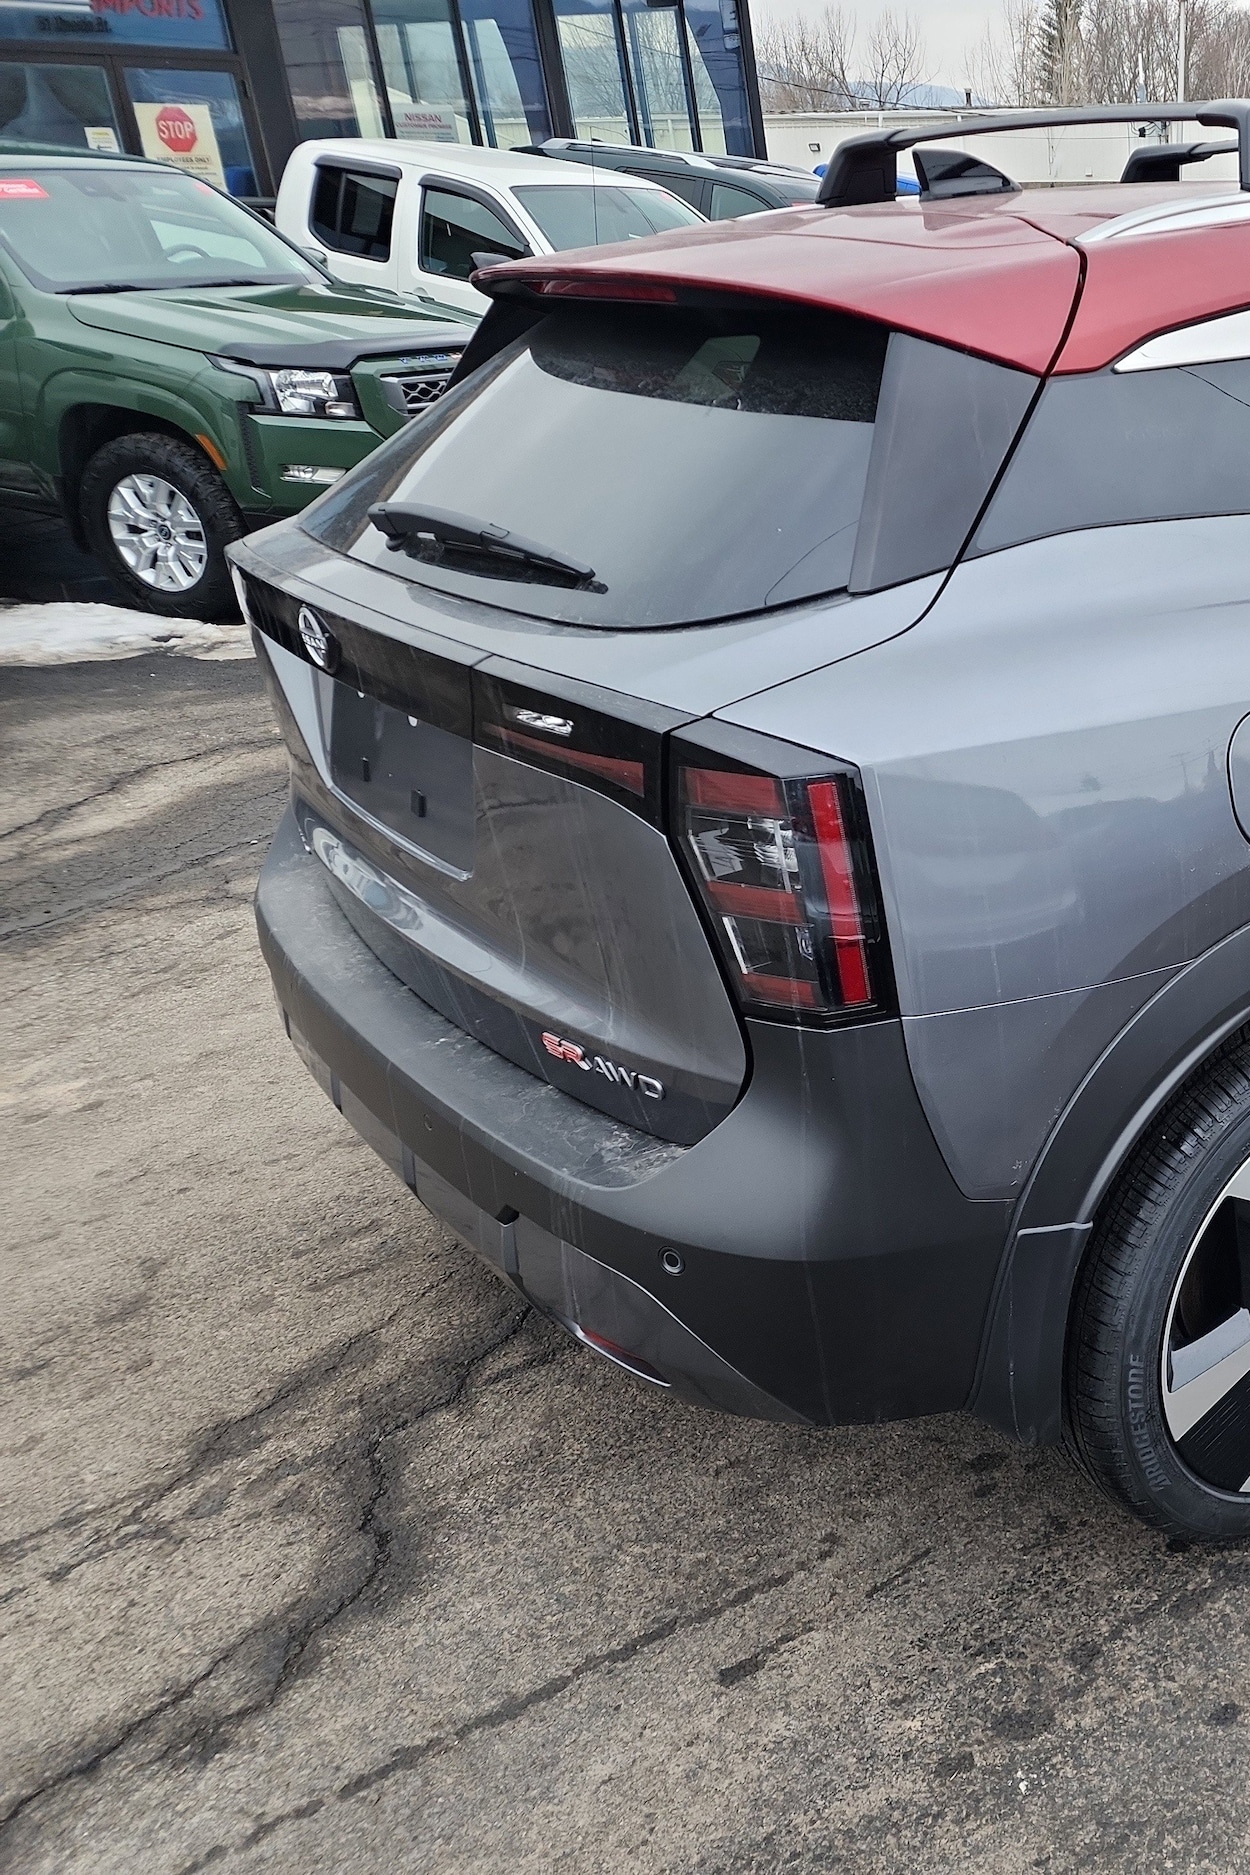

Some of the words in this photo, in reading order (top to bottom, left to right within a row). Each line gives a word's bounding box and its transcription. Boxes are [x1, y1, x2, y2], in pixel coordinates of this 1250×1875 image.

[404, 113, 442, 122] NISSAN
[158, 120, 195, 140] STOP
[541, 1032, 592, 1071] SR
[594, 1056, 664, 1100] AWD
